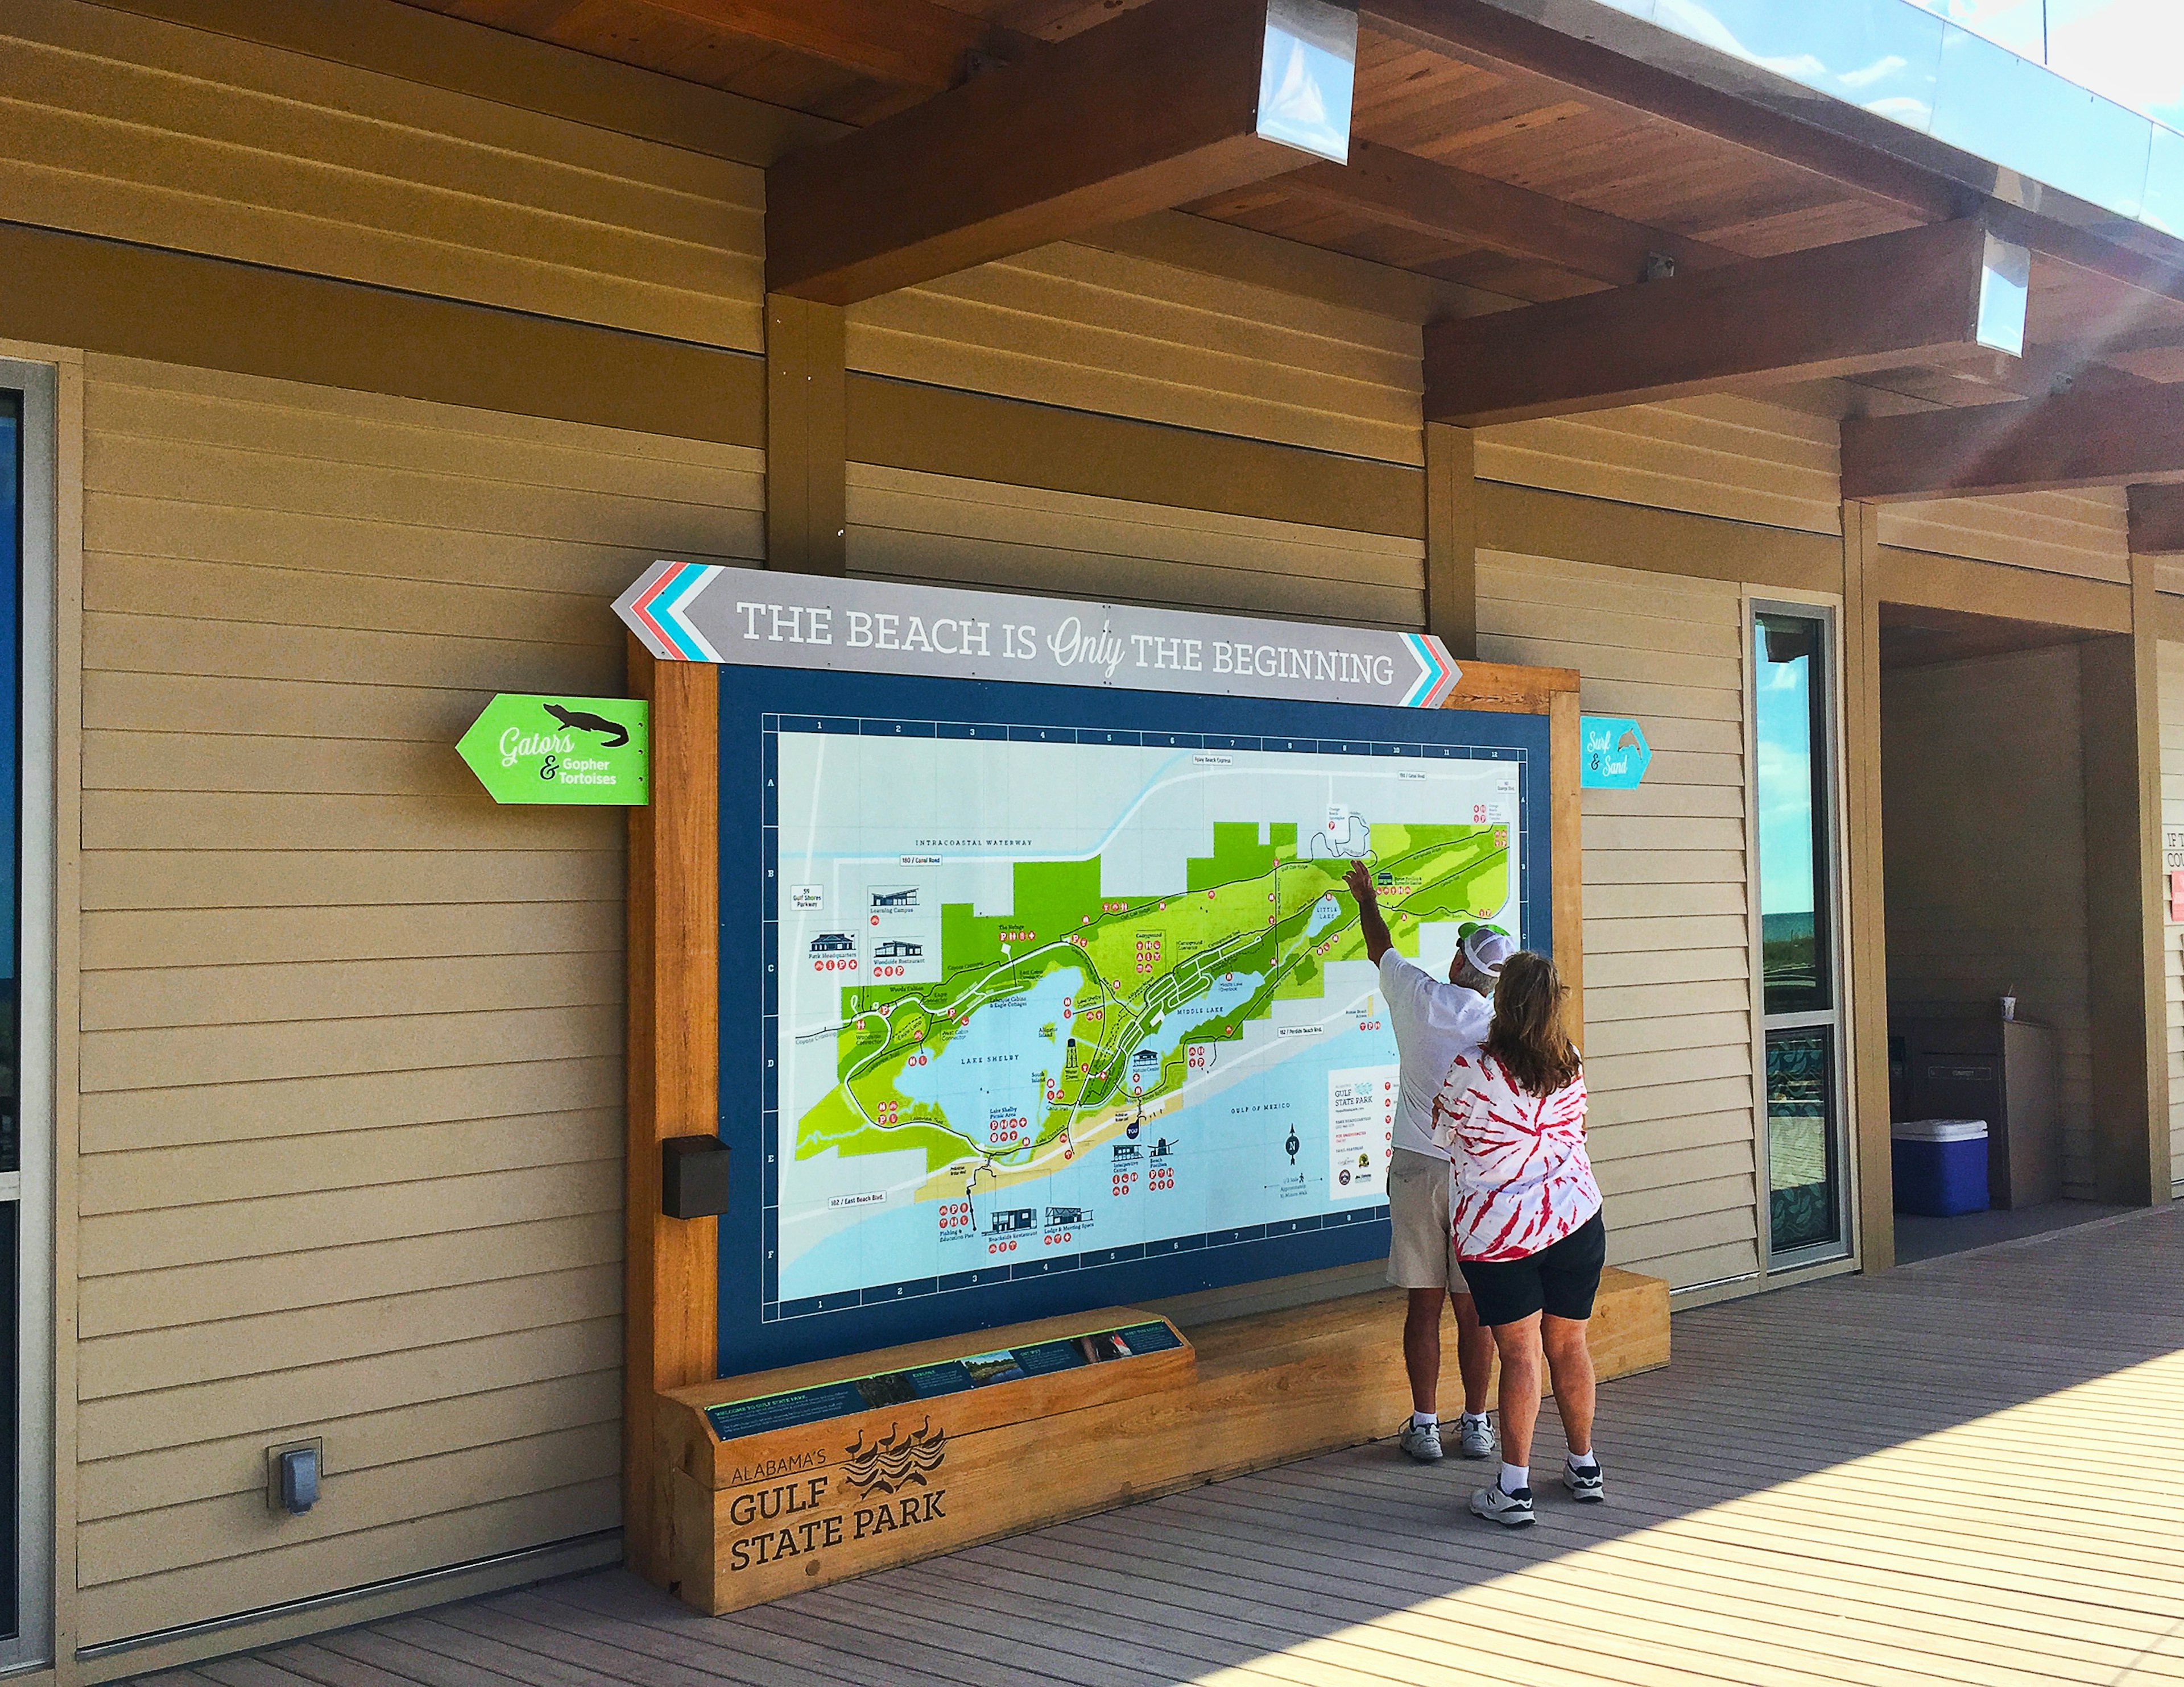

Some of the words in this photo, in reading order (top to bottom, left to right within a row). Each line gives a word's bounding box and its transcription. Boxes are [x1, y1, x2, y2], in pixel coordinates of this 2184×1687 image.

[736, 602, 832, 645] THE
[846, 611, 990, 656] BEACH
[1002, 625, 1037, 660] IS
[1048, 616, 1125, 678] Only
[1130, 635, 1202, 671] THE
[1212, 641, 1393, 685] BEGINNING
[500, 727, 574, 766] Gators
[1587, 731, 1611, 754] Surf
[540, 755, 559, 780] &
[562, 758, 609, 772] Gopher
[1591, 753, 1600, 770] &
[1603, 755, 1627, 776] Sand
[559, 772, 617, 785] Tortoises
[2168, 833, 2176, 847] IF
[815, 1031, 837, 1041] Crossing
[1335, 1098, 1354, 1106] STATE
[1289, 1142, 1296, 1150] N
[731, 1449, 826, 1483] ALABAMA'S
[730, 1477, 828, 1526] GULF
[1487, 1493, 1496, 1506] N
[731, 1515, 842, 1572] STATE
[853, 1490, 946, 1540] PARK
